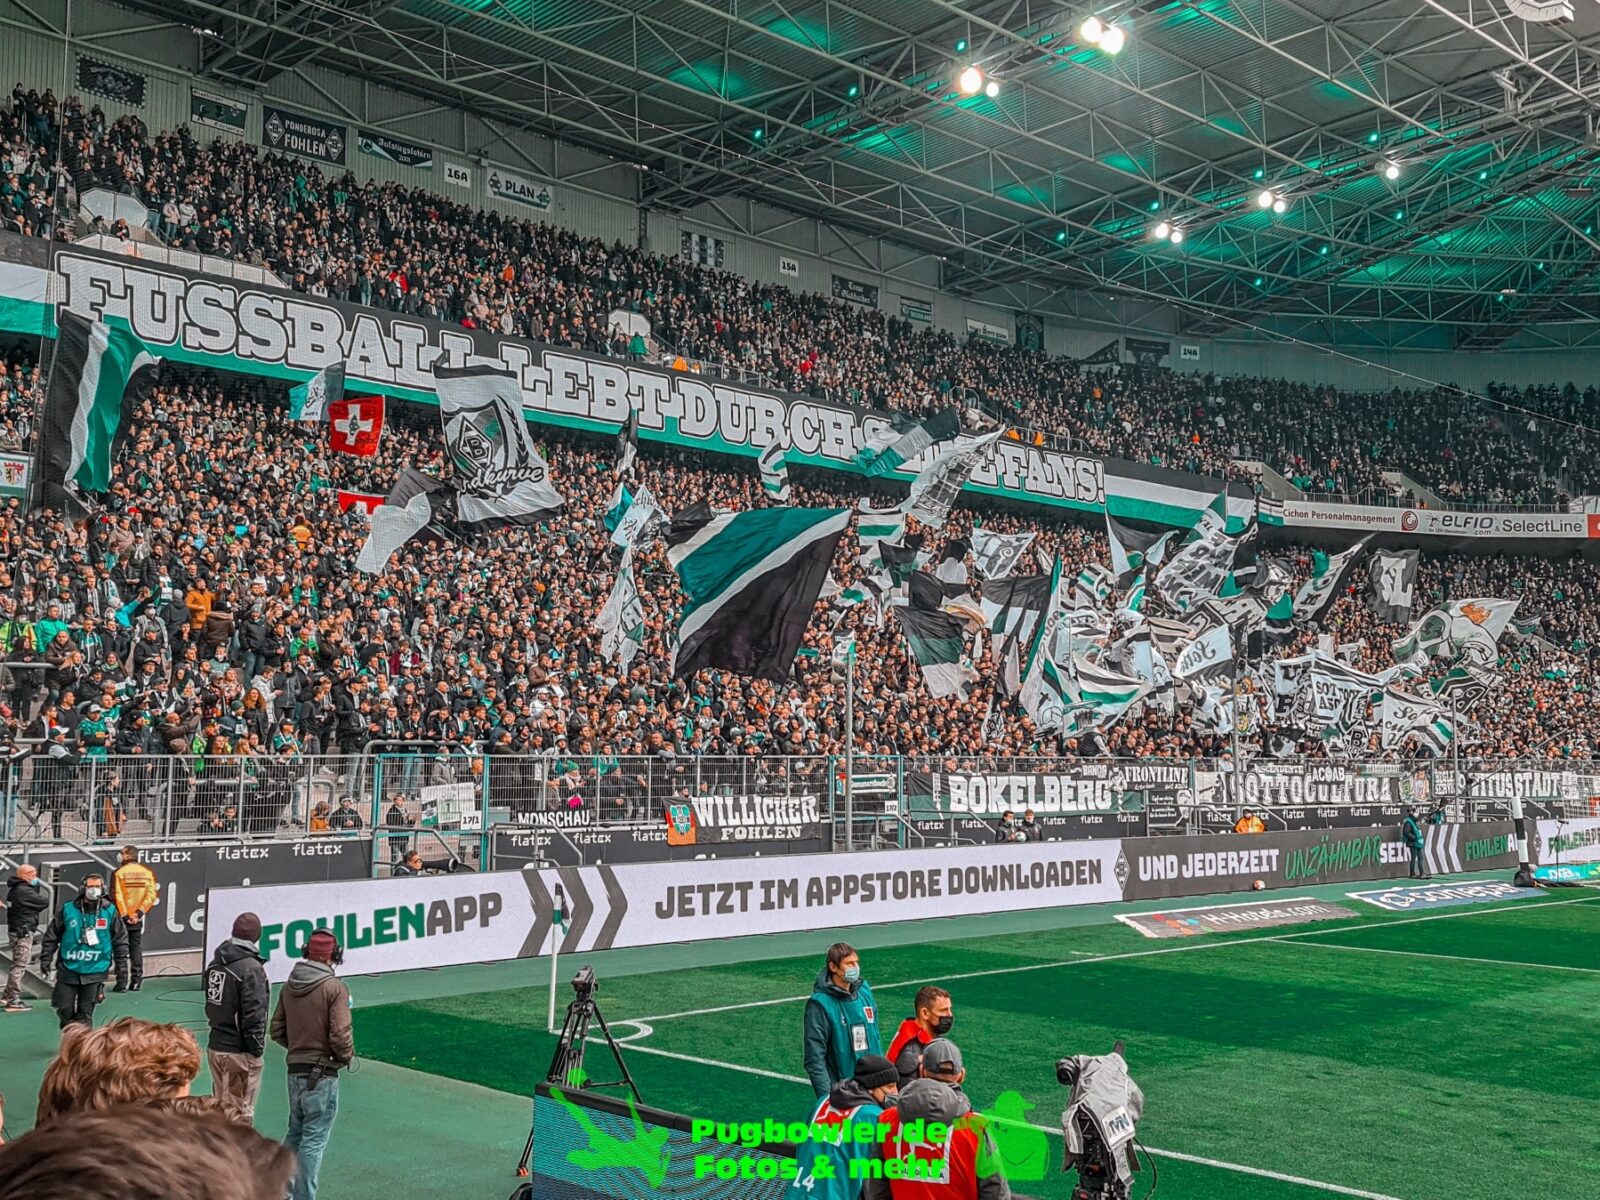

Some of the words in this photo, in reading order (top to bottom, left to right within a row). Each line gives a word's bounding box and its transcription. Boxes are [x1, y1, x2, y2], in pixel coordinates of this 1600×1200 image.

[285, 119, 326, 139] PONDEROSA
[284, 133, 326, 157] FOHLEN
[447, 167, 468, 182] 16A
[505, 180, 535, 199] PLAN
[782, 261, 797, 272] 15A
[1182, 348, 1198, 356] 14A
[55, 250, 499, 392] FUSSBALL
[499, 341, 673, 431] LEBT
[675, 377, 862, 463] DURCH
[997, 439, 1107, 505] FANS!
[1283, 508, 1309, 519] Cichon
[1311, 510, 1396, 525] Personalmanagement
[1502, 519, 1583, 533] SelectLine
[1124, 765, 1189, 784] FRONTLINE
[691, 794, 820, 827] WILLICHER
[1282, 809, 1305, 819] flatex
[1316, 808, 1339, 818] flatex
[1350, 807, 1371, 817] flatex
[1381, 806, 1401, 815] flatex
[462, 816, 480, 825] 17/1
[517, 809, 590, 828] MONSCHAU
[917, 820, 945, 831] flatex
[1042, 816, 1066, 825] flatex
[1081, 815, 1103, 824] flatex
[573, 832, 612, 845] flatex
[632, 830, 668, 842] flatex
[720, 825, 803, 841] FOHLEN
[510, 834, 551, 847] flatex
[1465, 831, 1528, 861] FOHLENA
[138, 850, 192, 864] flatex
[216, 846, 269, 861] flatex
[292, 843, 342, 857] flatex
[1138, 852, 1178, 882] UND
[1181, 848, 1279, 878] JEDERZEIT
[1284, 835, 1383, 881] UNZÄHMBAR
[655, 881, 755, 919] JETZT
[759, 877, 799, 911] IM
[805, 867, 942, 908] APPSTORE
[948, 857, 1102, 897] DOWNLOADEN
[1411, 883, 1526, 903] sonepar
[1202, 903, 1330, 925] H-Hotels.com
[66, 950, 102, 961] HOST
